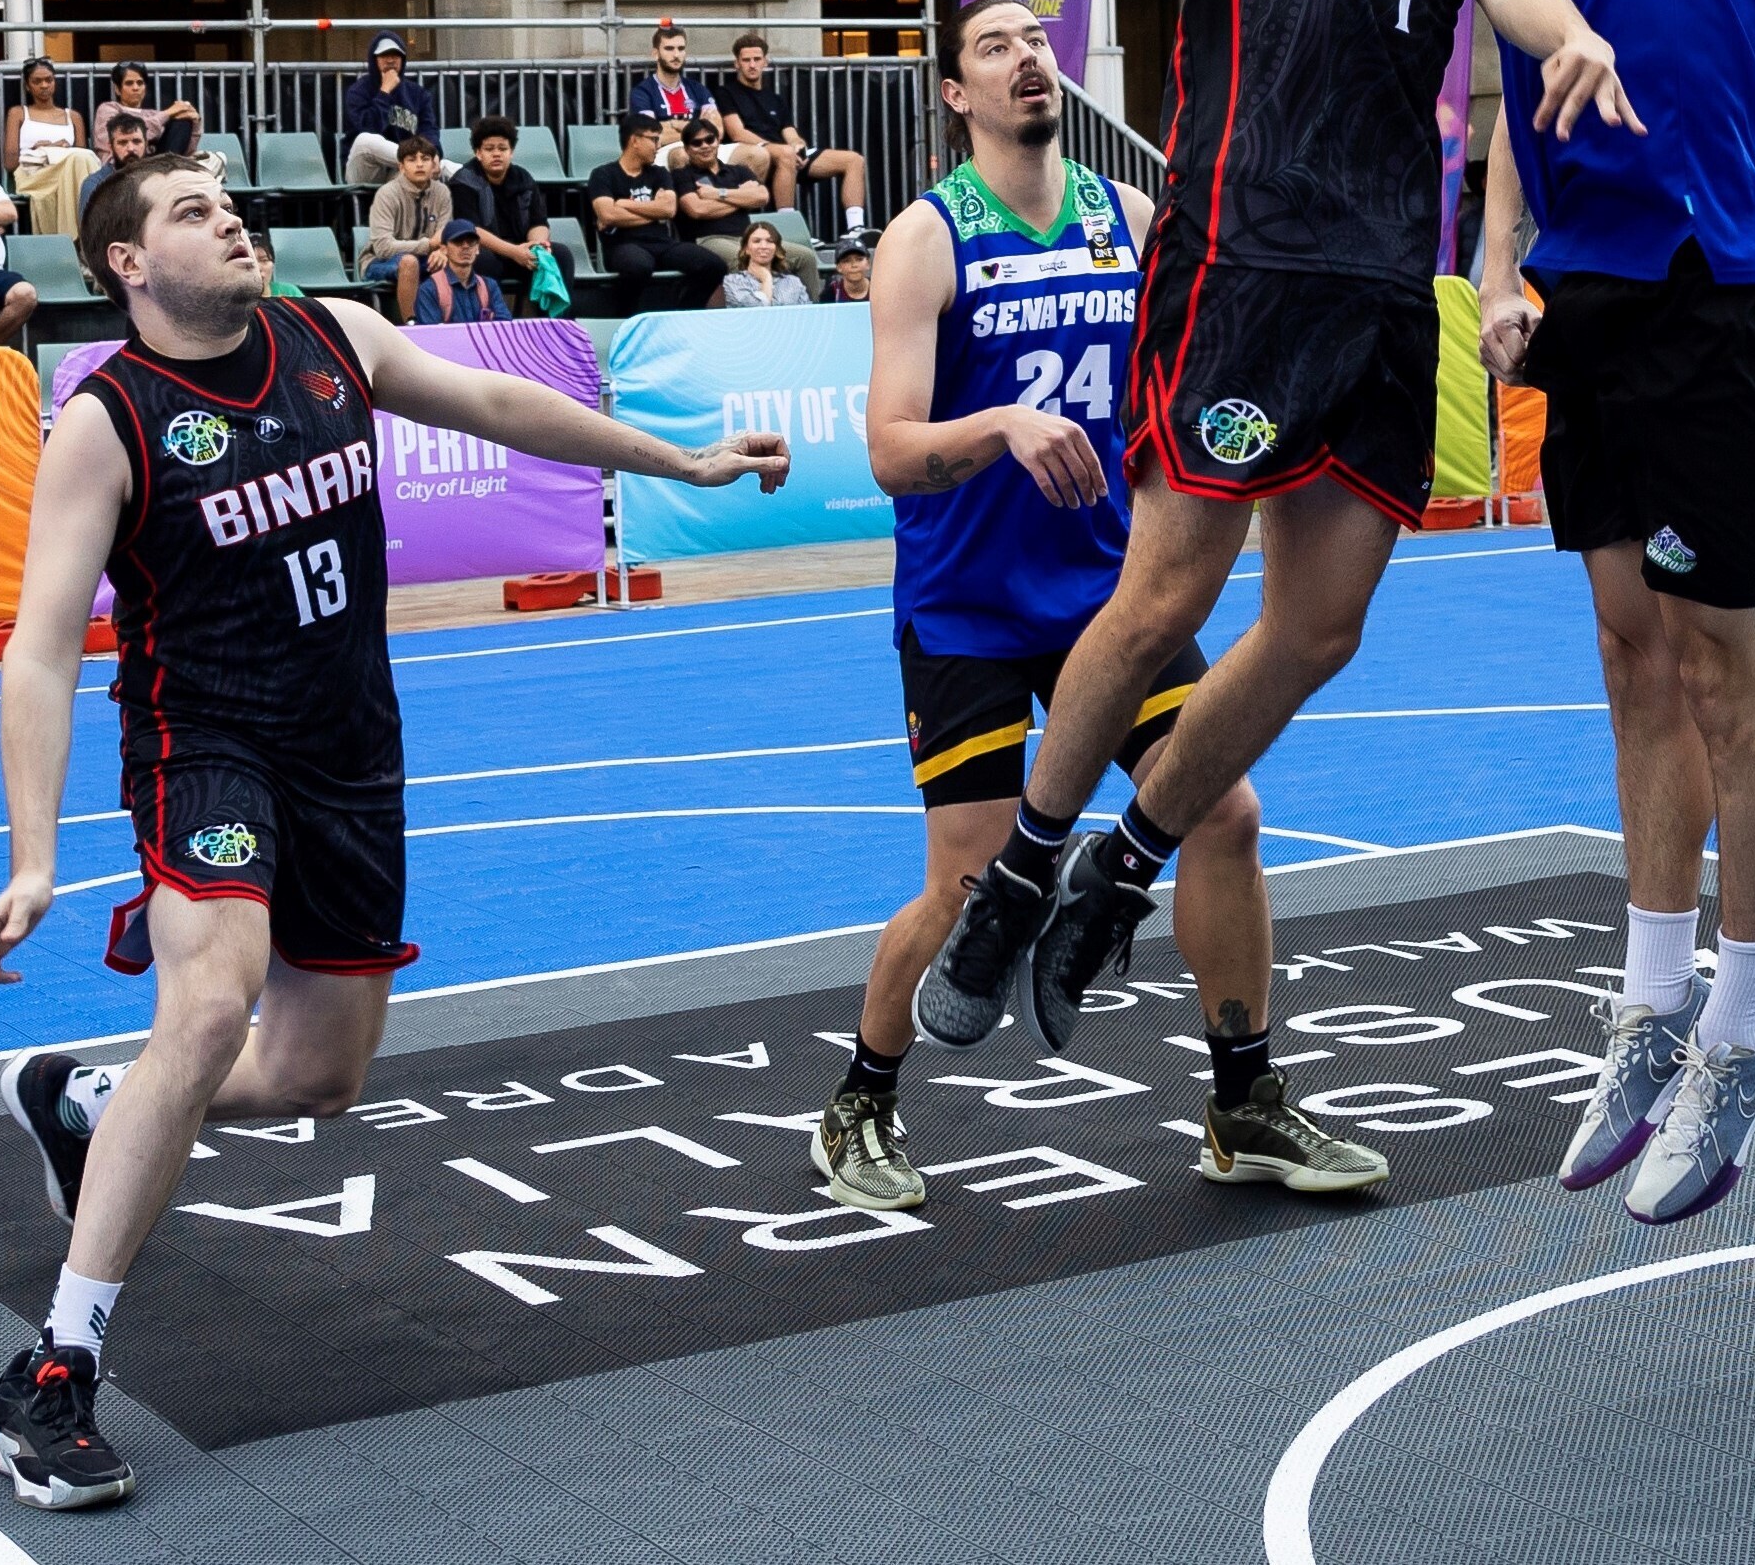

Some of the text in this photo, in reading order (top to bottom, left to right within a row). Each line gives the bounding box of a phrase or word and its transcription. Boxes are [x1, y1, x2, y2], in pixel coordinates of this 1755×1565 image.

[972, 288, 1135, 338] SENATORS
[332, 376, 346, 410] BINAR
[722, 386, 839, 444] CITY OF
[1016, 344, 1113, 420] 24
[199, 440, 372, 547] BINAR
[396, 476, 508, 502] City of Light
[283, 539, 347, 627] 13
[1077, 914, 1616, 1016] WALKNG
[174, 949, 1719, 1239] USTRALIA
[190, 1063, 665, 1160] DREA
